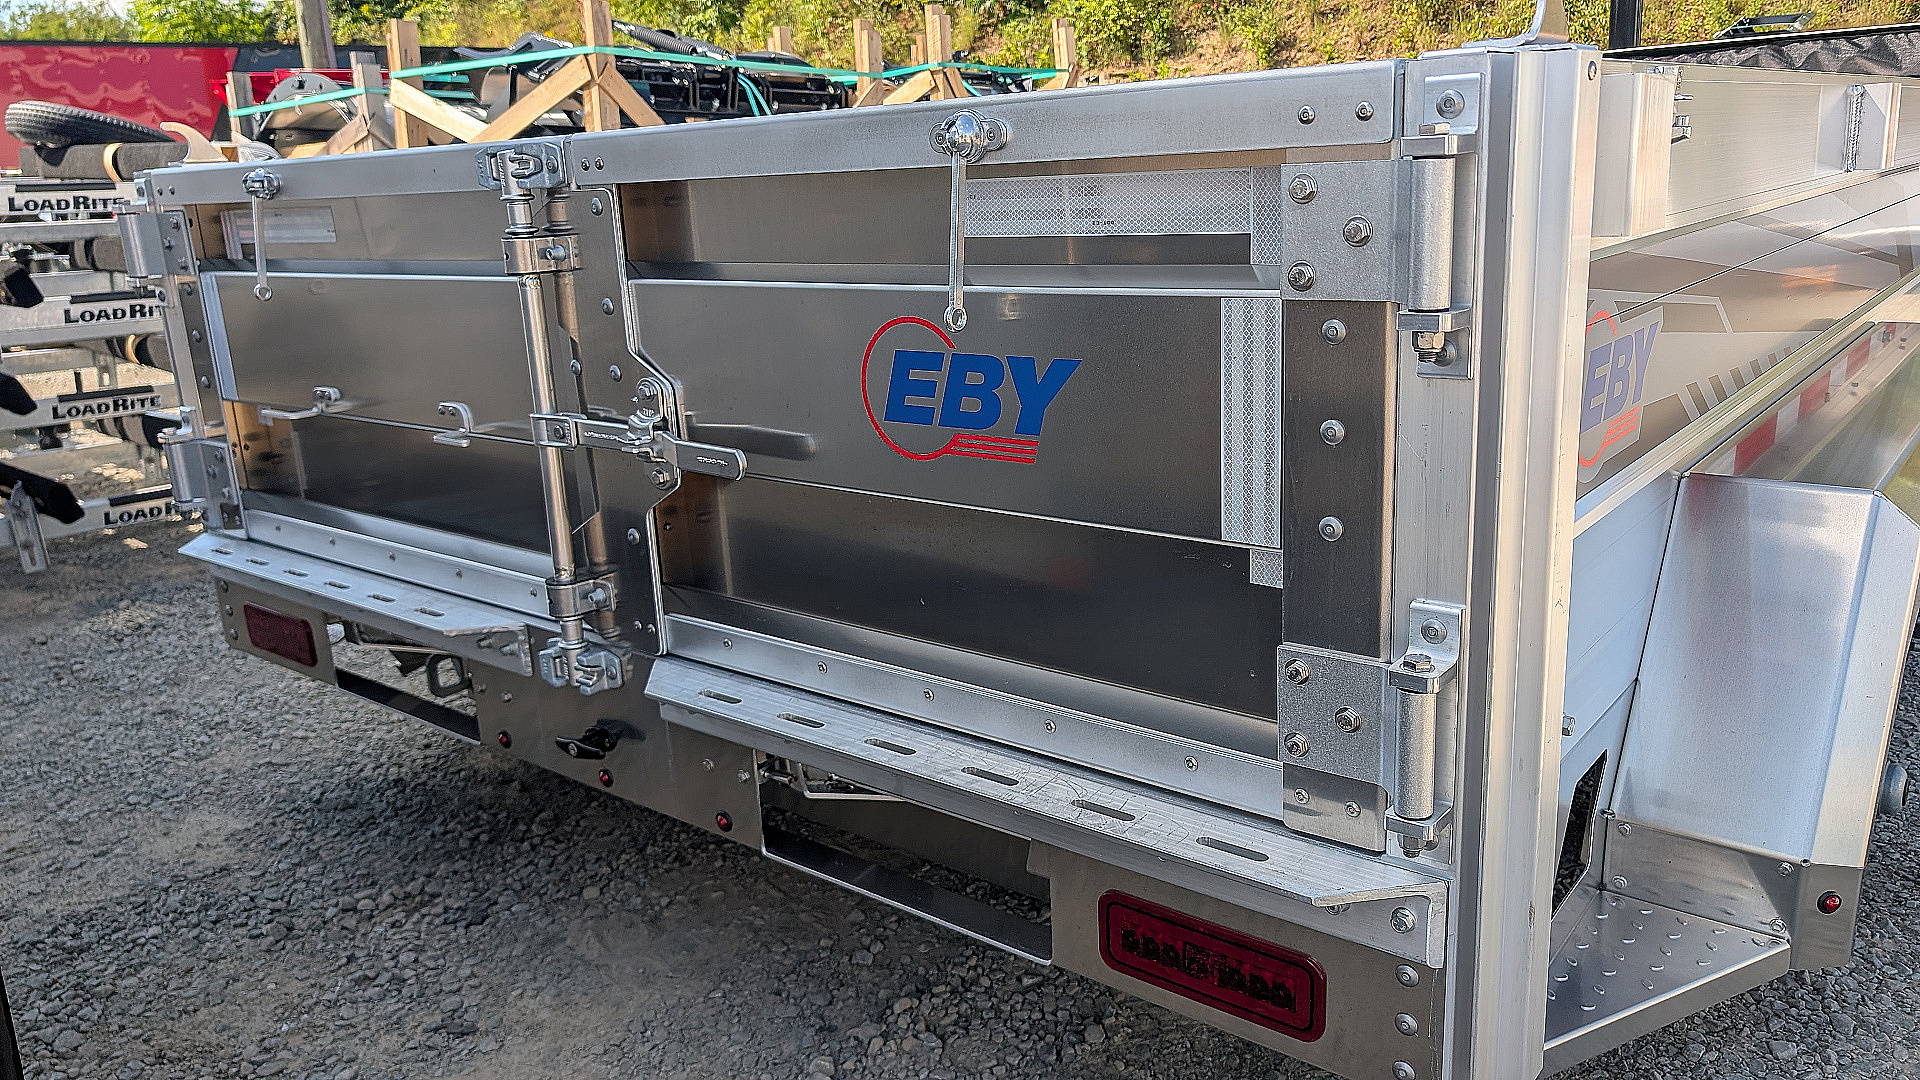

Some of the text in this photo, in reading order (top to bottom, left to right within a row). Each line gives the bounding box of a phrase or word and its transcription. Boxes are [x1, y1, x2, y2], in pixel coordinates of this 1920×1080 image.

[64, 304, 162, 324] LOADRIT
[884, 349, 1083, 436] EBY
[1580, 320, 1659, 434] EBY
